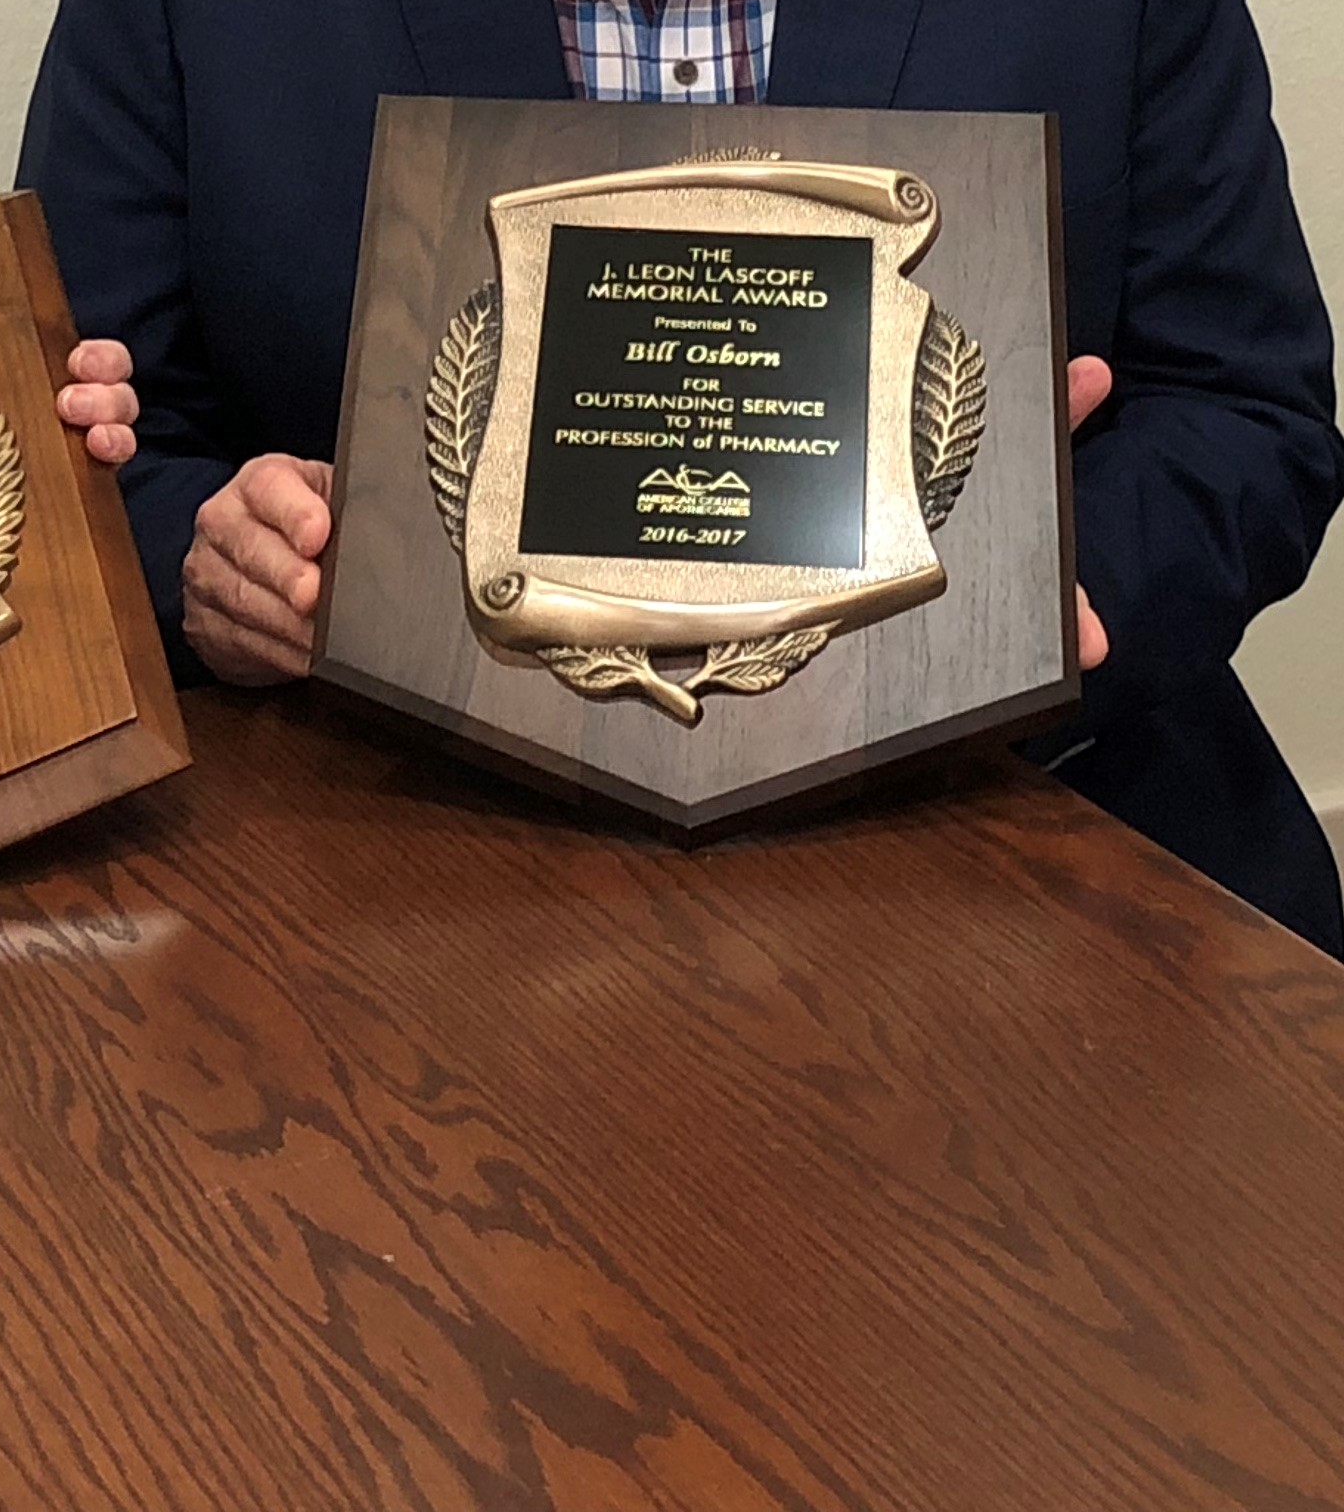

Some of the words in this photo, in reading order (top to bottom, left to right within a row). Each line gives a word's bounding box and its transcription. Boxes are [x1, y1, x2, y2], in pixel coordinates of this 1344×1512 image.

[689, 248, 732, 263] THE
[602, 262, 617, 281] J.
[628, 264, 695, 282] LEON
[705, 266, 814, 287] LASCOFF
[587, 283, 723, 303] MEMORIAL
[732, 288, 827, 308] AWARD
[654, 316, 731, 331] Presented
[738, 318, 757, 333] To
[624, 340, 681, 363] Bill
[686, 343, 781, 368] Osborn
[683, 377, 720, 392] FOR
[575, 392, 734, 413] OUTSTANDING
[742, 399, 825, 418] SERVICE
[665, 414, 691, 429] TO
[698, 416, 733, 430] THE
[555, 428, 685, 449] PROFESSION
[693, 435, 714, 449] of
[720, 436, 841, 456] PHARMACY
[636, 503, 655, 513] OF
[637, 493, 696, 504] AMERICAN
[698, 496, 751, 507] COLLEGE
[639, 526, 747, 546] 2016-2017
